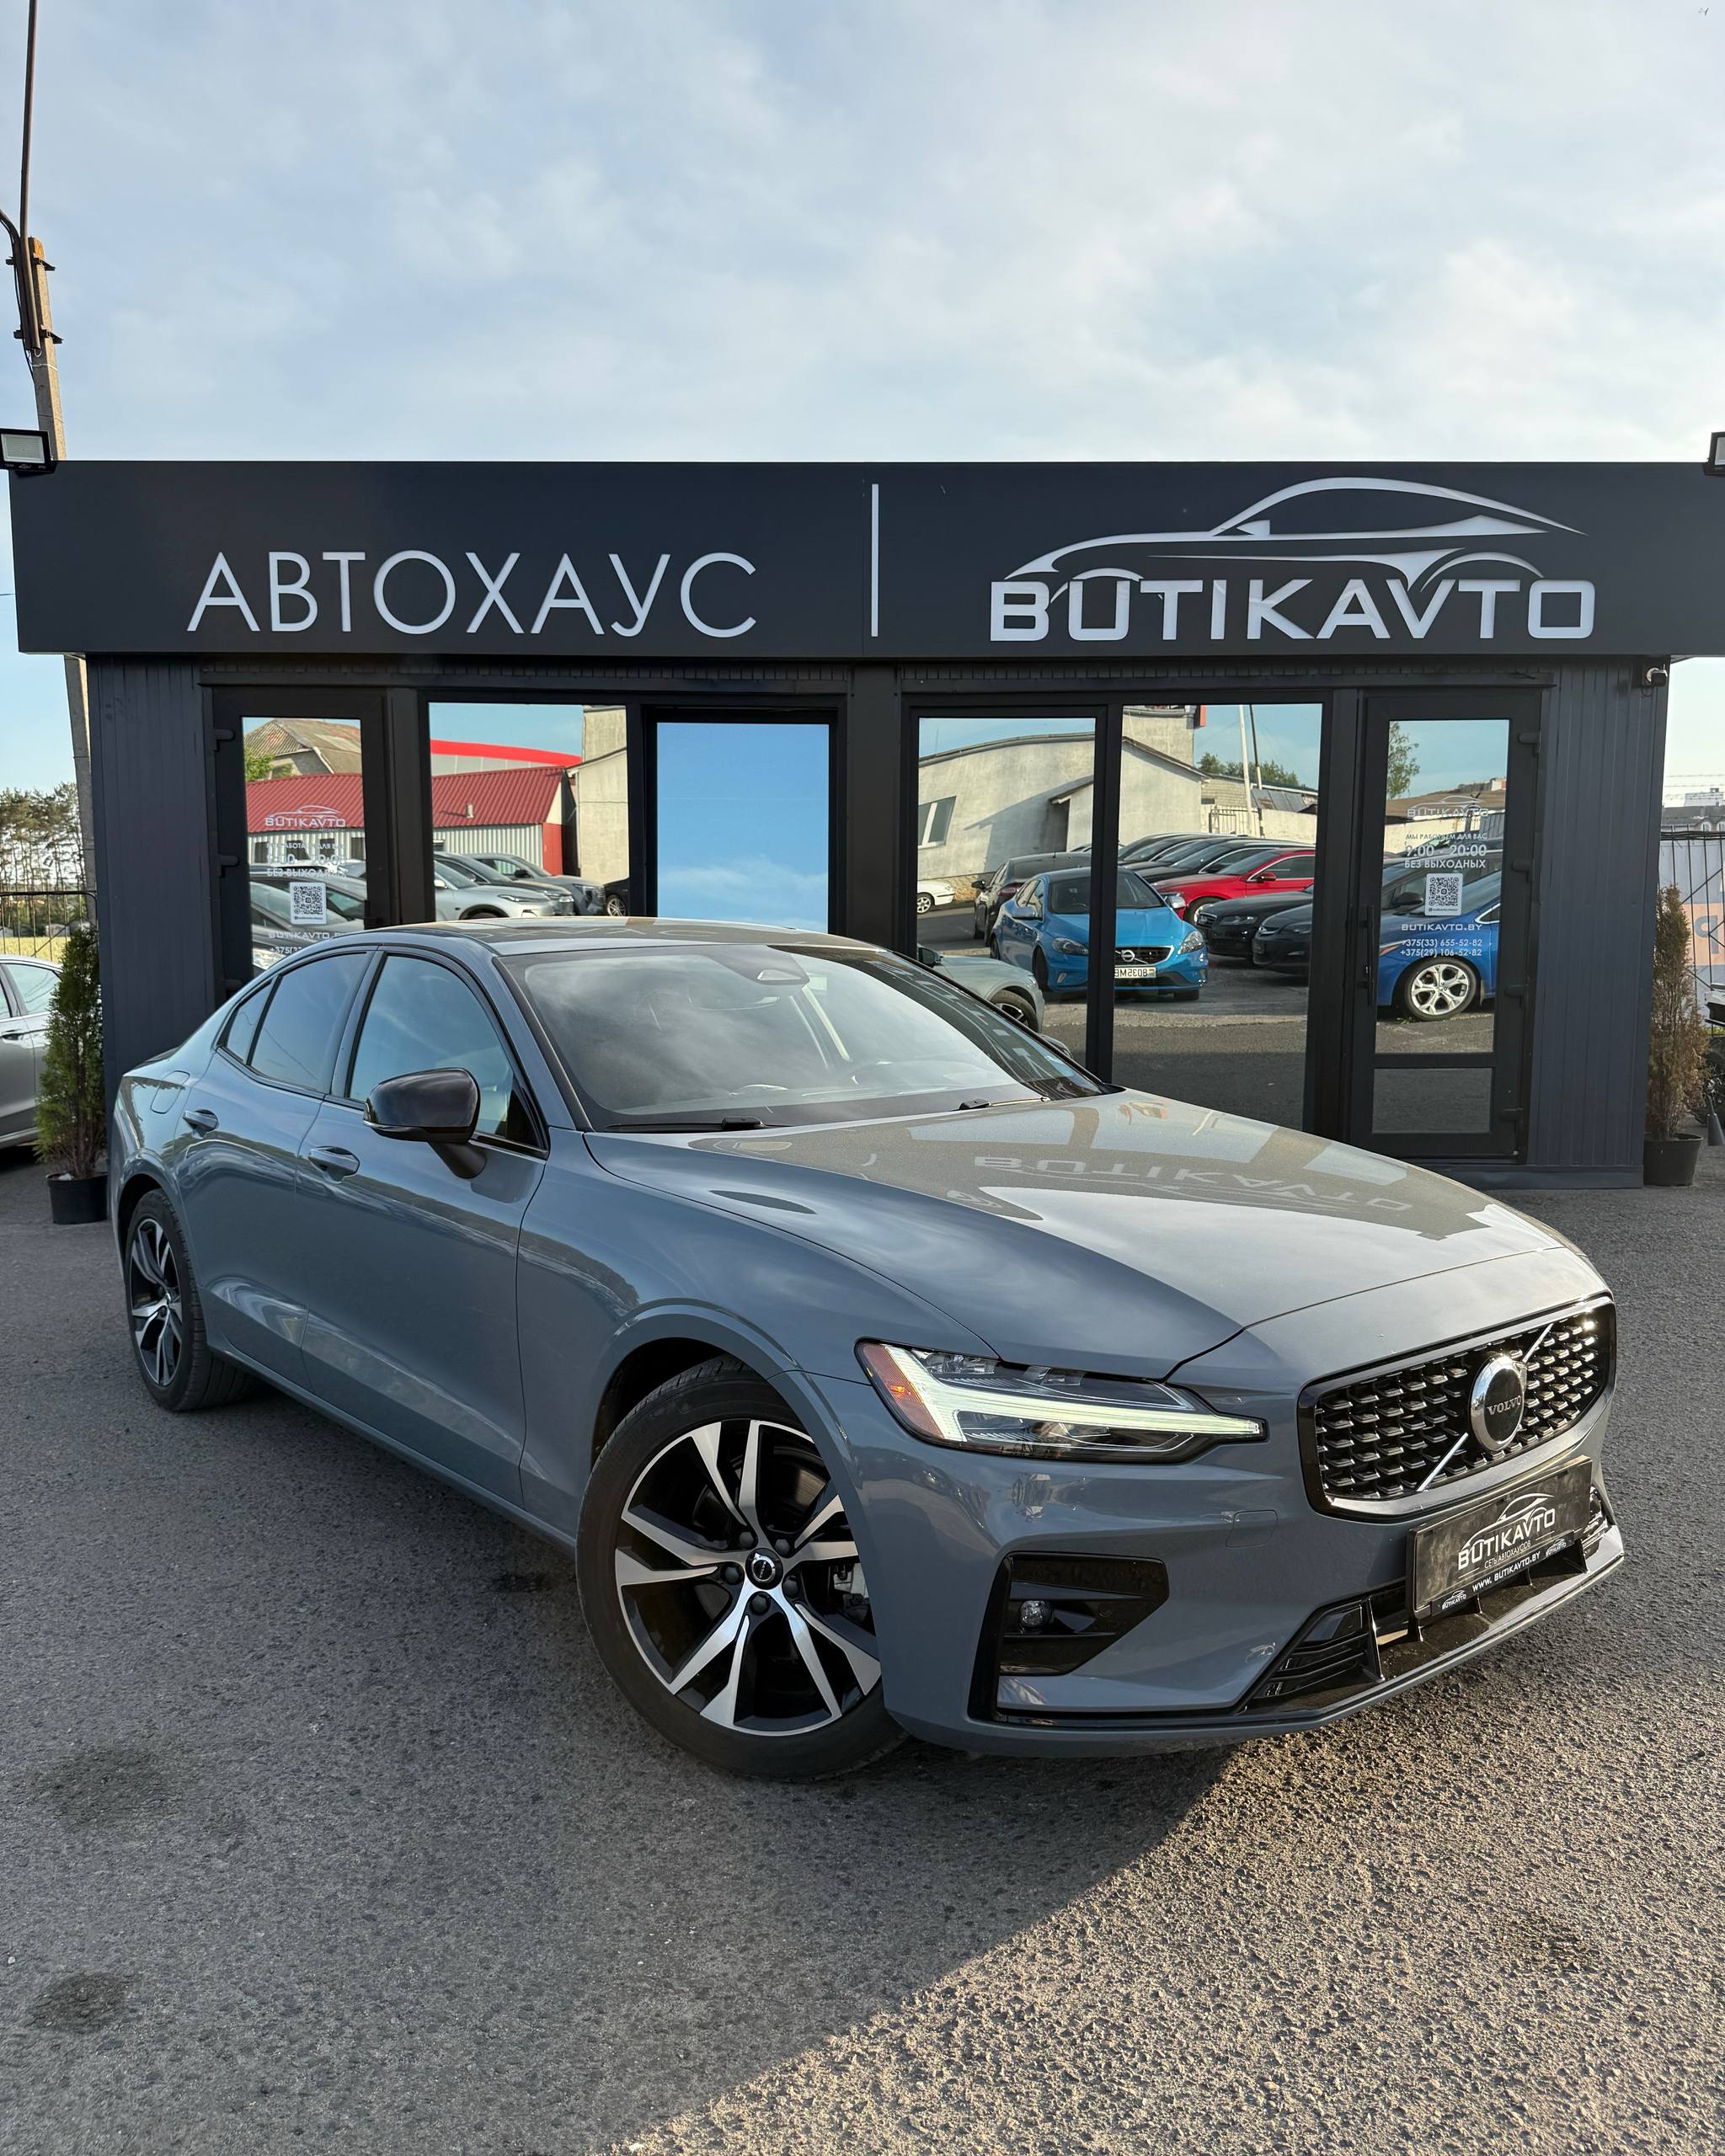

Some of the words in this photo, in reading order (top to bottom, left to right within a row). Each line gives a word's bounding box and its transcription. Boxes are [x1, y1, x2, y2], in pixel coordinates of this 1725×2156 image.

[187, 550, 757, 638] АВТОХАУС
[990, 578, 1596, 642] BUTIKAVTO
[264, 817, 346, 828] BUTIKAVTO
[1406, 845, 1434, 857] 9:00
[1449, 845, 1487, 857] 20:00
[1405, 860, 1421, 868] БЕЗ
[1424, 860, 1486, 868] ВЫХОДНЫХ
[1400, 949, 1438, 958] +375(29)
[1486, 1395, 1522, 1415] VOLVO
[1458, 1508, 1556, 1571] BUTIKAVTO
[1484, 1556, 1498, 1569] СЕТЬ
[1498, 1540, 1531, 1562] АВТОХАУСОВ
[1471, 1577, 1493, 1593] WWW.
[1494, 1550, 1541, 1582] BUTIKAVTO.BY
